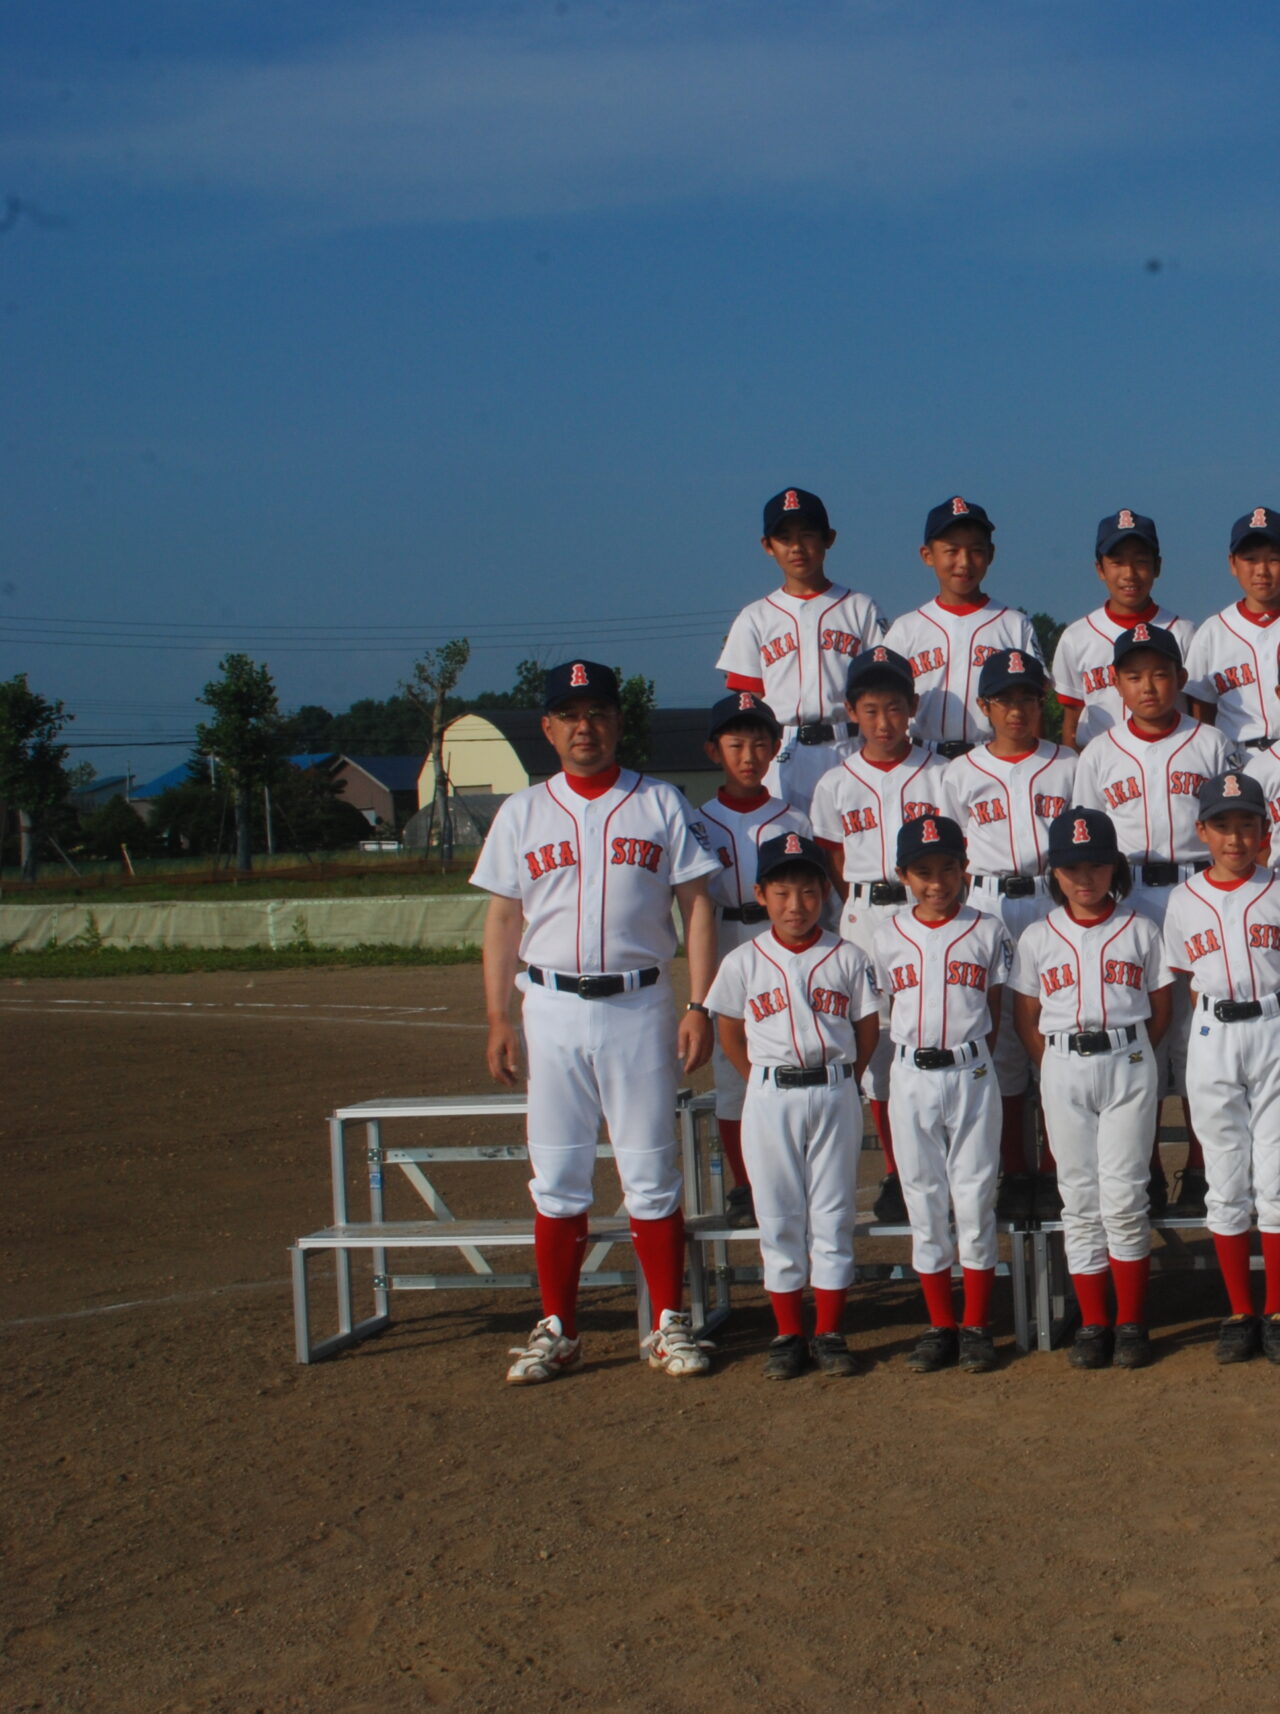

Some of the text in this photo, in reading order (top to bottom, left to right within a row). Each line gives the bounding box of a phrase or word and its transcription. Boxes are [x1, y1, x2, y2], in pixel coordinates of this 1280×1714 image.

[783, 490, 800, 511] A
[953, 497, 969, 515] A
[1117, 509, 1135, 529] A
[1249, 507, 1267, 528] A
[1132, 622, 1151, 643] A
[760, 632, 798, 667] AKA
[873, 647, 889, 663] A
[1008, 651, 1026, 673] A
[570, 663, 589, 687] A
[1213, 663, 1257, 695] AKA
[739, 692, 756, 710] A
[968, 797, 1007, 826] KA
[921, 819, 940, 843] A
[1072, 818, 1091, 844] A
[784, 833, 802, 854] A
[525, 837, 663, 881] AKA SIYA
[749, 987, 788, 1022] AKA
